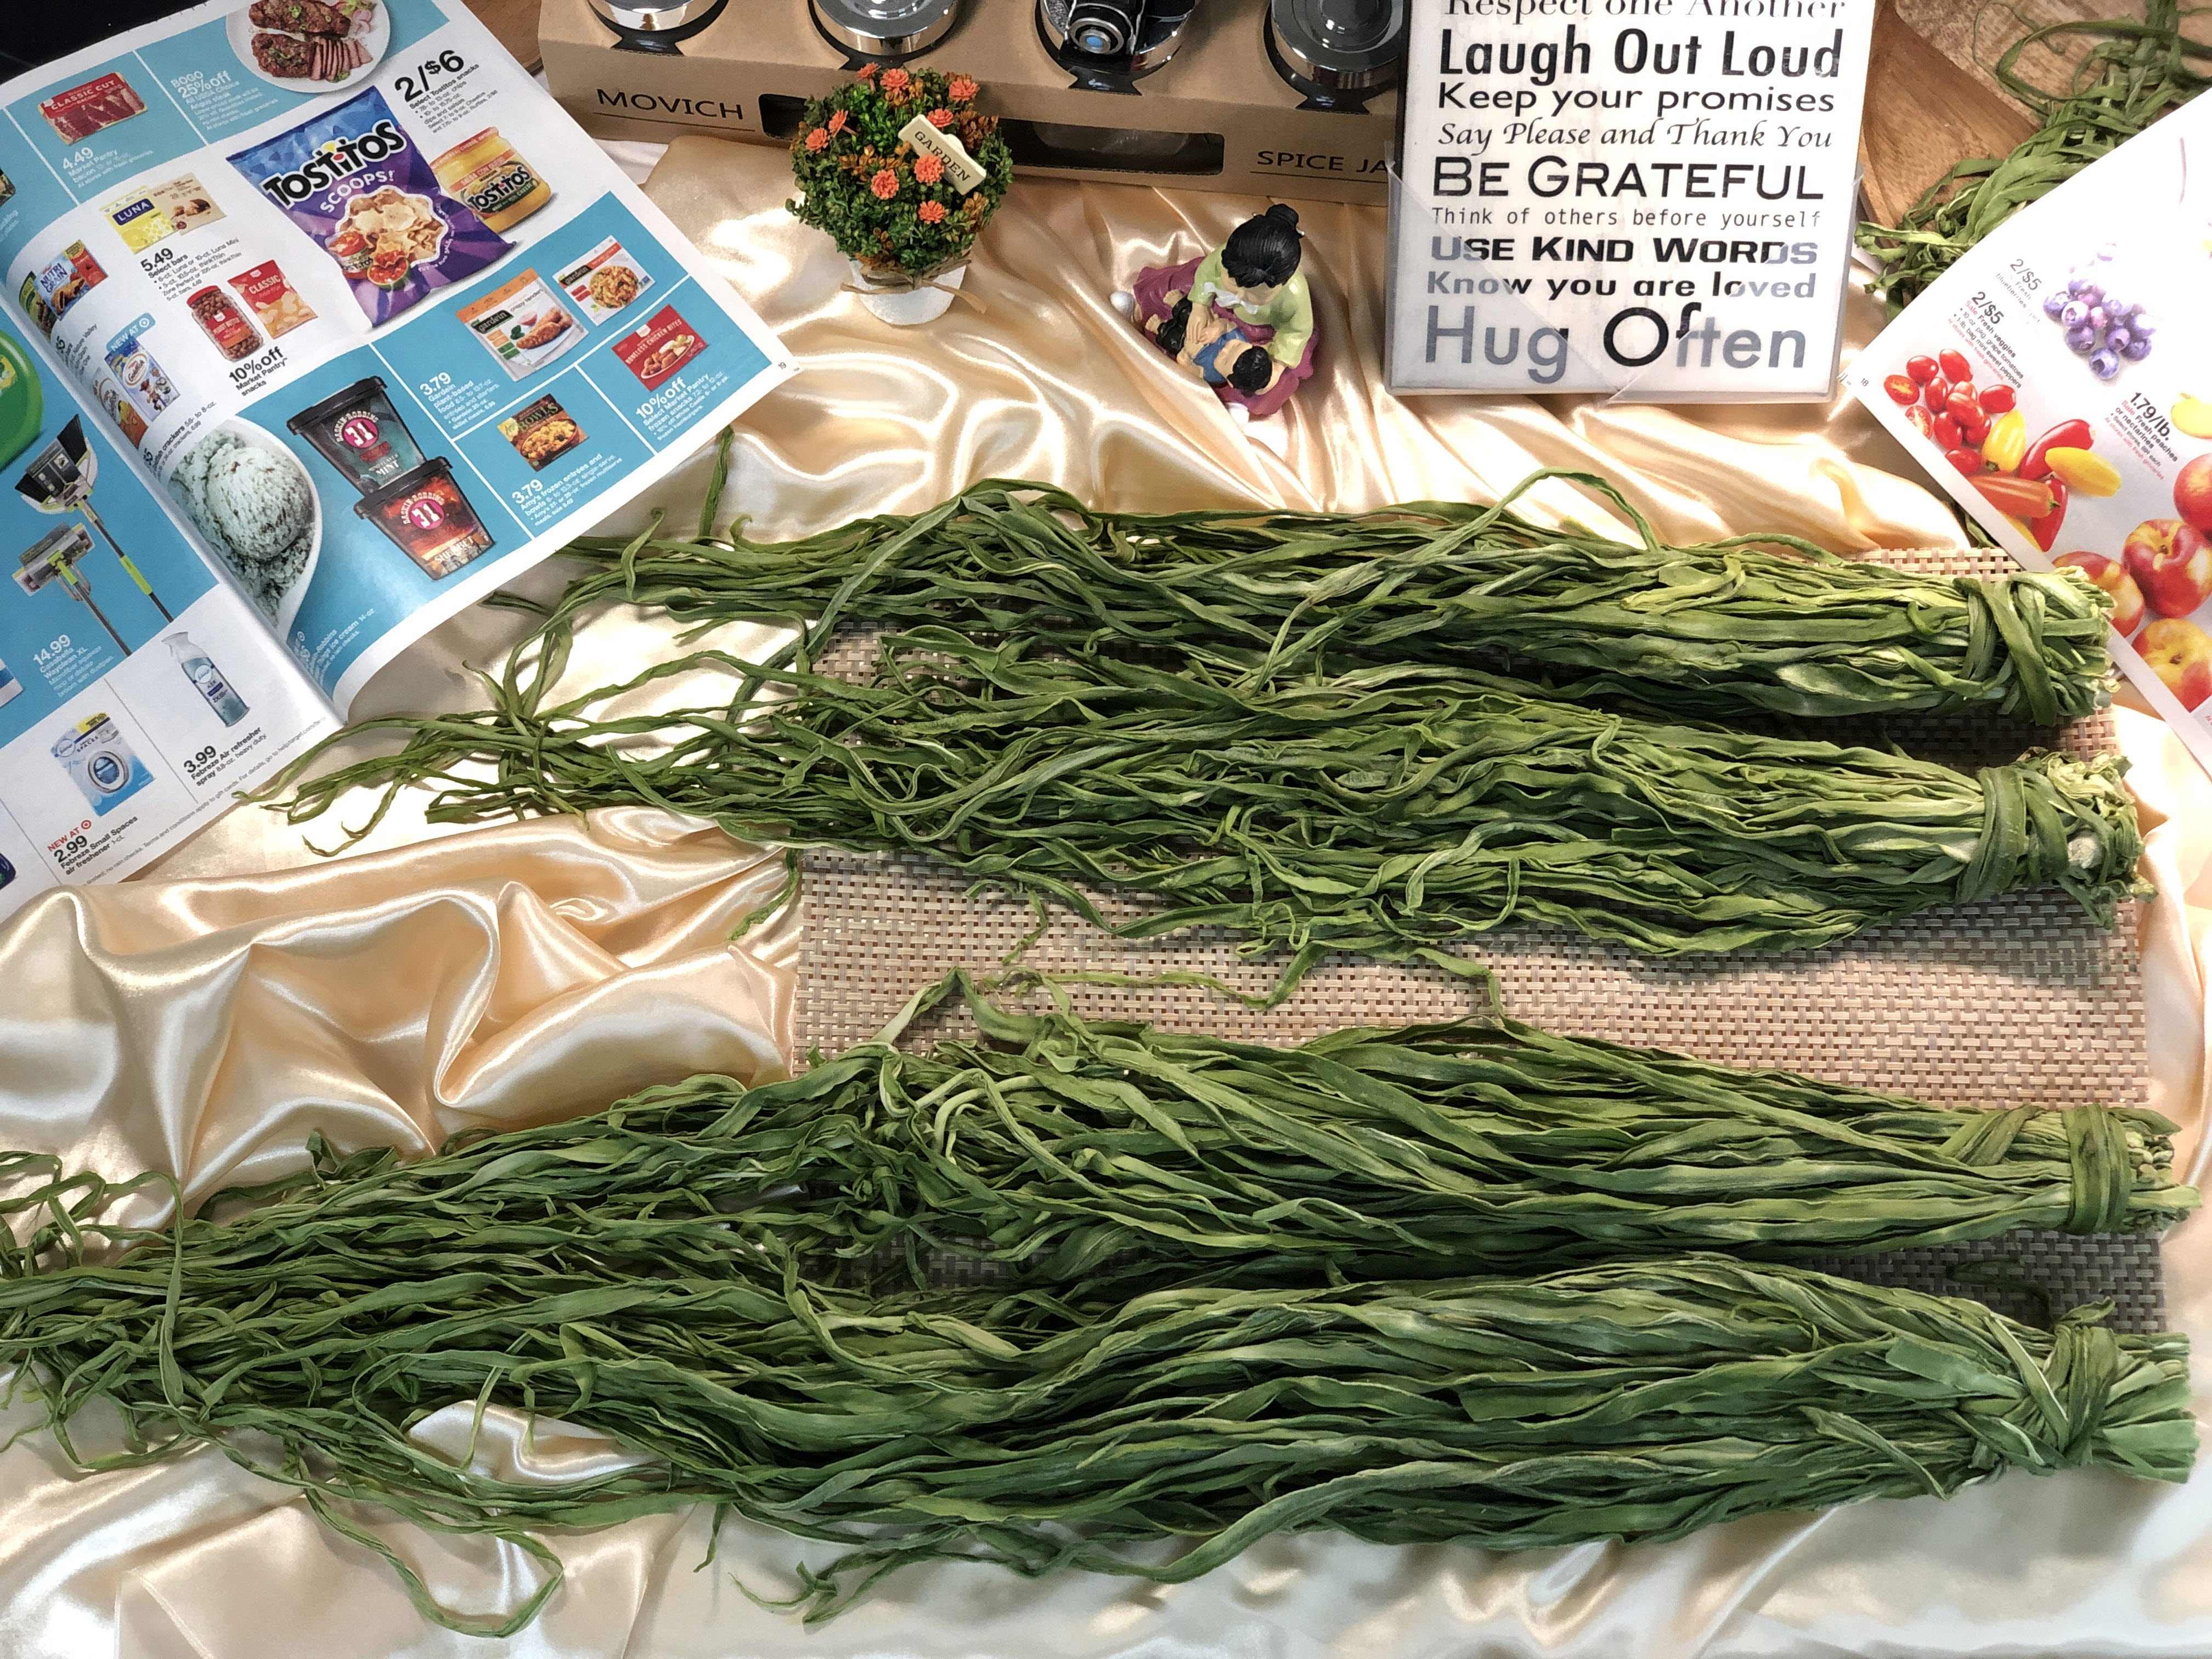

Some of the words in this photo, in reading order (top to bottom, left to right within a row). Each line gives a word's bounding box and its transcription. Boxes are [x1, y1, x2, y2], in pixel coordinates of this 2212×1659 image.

[1444, 0, 1592, 26] Respect
[1606, 0, 1674, 17] one
[1689, 0, 1846, 19] Another
[1440, 24, 1590, 86] Laugh
[1615, 27, 1702, 77] Out
[1722, 29, 1844, 77] Loud
[171, 71, 204, 88] BOGO
[395, 50, 464, 102] 2/$6
[410, 95, 431, 109] Select
[430, 80, 456, 96] Tostitos
[456, 64, 479, 80] snacks
[51, 88, 94, 110] CLASSIC
[95, 80, 115, 91] CUT
[597, 89, 743, 120] MOVICH
[1438, 83, 1537, 117] Keep
[1552, 89, 1643, 117] your
[1657, 86, 1835, 117] promises
[1437, 122, 1493, 156] Say
[1503, 118, 1590, 145] Please
[1600, 118, 1664, 145] and
[1667, 118, 1766, 148] Thank
[1777, 124, 1832, 148] You
[63, 147, 93, 169] 4.49
[915, 131, 970, 181] GARDEN
[1257, 151, 1344, 171] SPICE
[320, 170, 395, 213] SCOOPS!
[1434, 157, 1509, 196] BE
[1527, 156, 1824, 200] GRATEFUL
[117, 201, 150, 222] LUNA
[1432, 208, 1492, 224] Think
[1506, 208, 1530, 225] of
[1545, 208, 1617, 225] others
[1633, 208, 1706, 227] before
[1720, 211, 1821, 230] yourself
[140, 248, 173, 271] 5.49
[1431, 237, 1514, 261] USE
[1532, 237, 1633, 262] KIND
[1654, 239, 1818, 264] WORDS
[41, 263, 63, 288] NUTRI
[148, 263, 171, 278] Select
[171, 255, 188, 266] bars
[565, 266, 589, 284] gardein
[2010, 258, 2042, 290] 2/$5
[249, 275, 281, 294] CLASSIC
[1426, 272, 1531, 294] Know
[1547, 278, 1616, 301] you
[1633, 278, 1695, 297] are
[1712, 272, 1815, 298] loved
[478, 312, 507, 332] gardein
[1971, 291, 2004, 324] 2/$5
[111, 333, 129, 352] NEW
[129, 325, 139, 336] AT
[1426, 306, 1569, 384] Hug
[1603, 302, 1805, 369] Often
[1966, 301, 1978, 315] Sale
[1977, 314, 1994, 334] Fresh
[1994, 333, 2016, 358] veggies
[778, 362, 787, 370] 19
[1966, 328, 1977, 341] bag
[1976, 339, 1988, 351] mini
[1986, 350, 2001, 366] sweet
[1999, 366, 2022, 388] peppers
[1986, 339, 2001, 355] grape
[2000, 353, 2024, 379] tomatoes
[236, 374, 262, 391] Market
[241, 380, 267, 396] snacks
[420, 372, 450, 395] 3.79
[644, 409, 665, 426] Select
[664, 391, 687, 410] Market
[687, 374, 709, 392] Pantry
[518, 402, 558, 433] BOWLS
[2130, 392, 2170, 441] 1.79/lb.
[162, 426, 185, 450] crackers
[2123, 415, 2154, 449] nectarines
[2135, 415, 2153, 435] Fresh
[2151, 434, 2178, 462] peaches
[512, 479, 543, 504] 3.79
[33, 634, 70, 665] 14.99
[184, 746, 216, 773] 3.99
[191, 759, 219, 780] Febreze
[219, 750, 229, 760] Air
[230, 727, 261, 752] refresher
[196, 771, 216, 786] spray
[235, 744, 253, 758] heavy
[47, 835, 67, 852] NEW
[70, 827, 80, 838] AT
[54, 835, 88, 863] 2.99
[60, 845, 90, 870] Febreze
[89, 833, 111, 850] Small
[111, 816, 138, 836] Spaces
[65, 865, 76, 876] air
[76, 843, 111, 868] freshener
